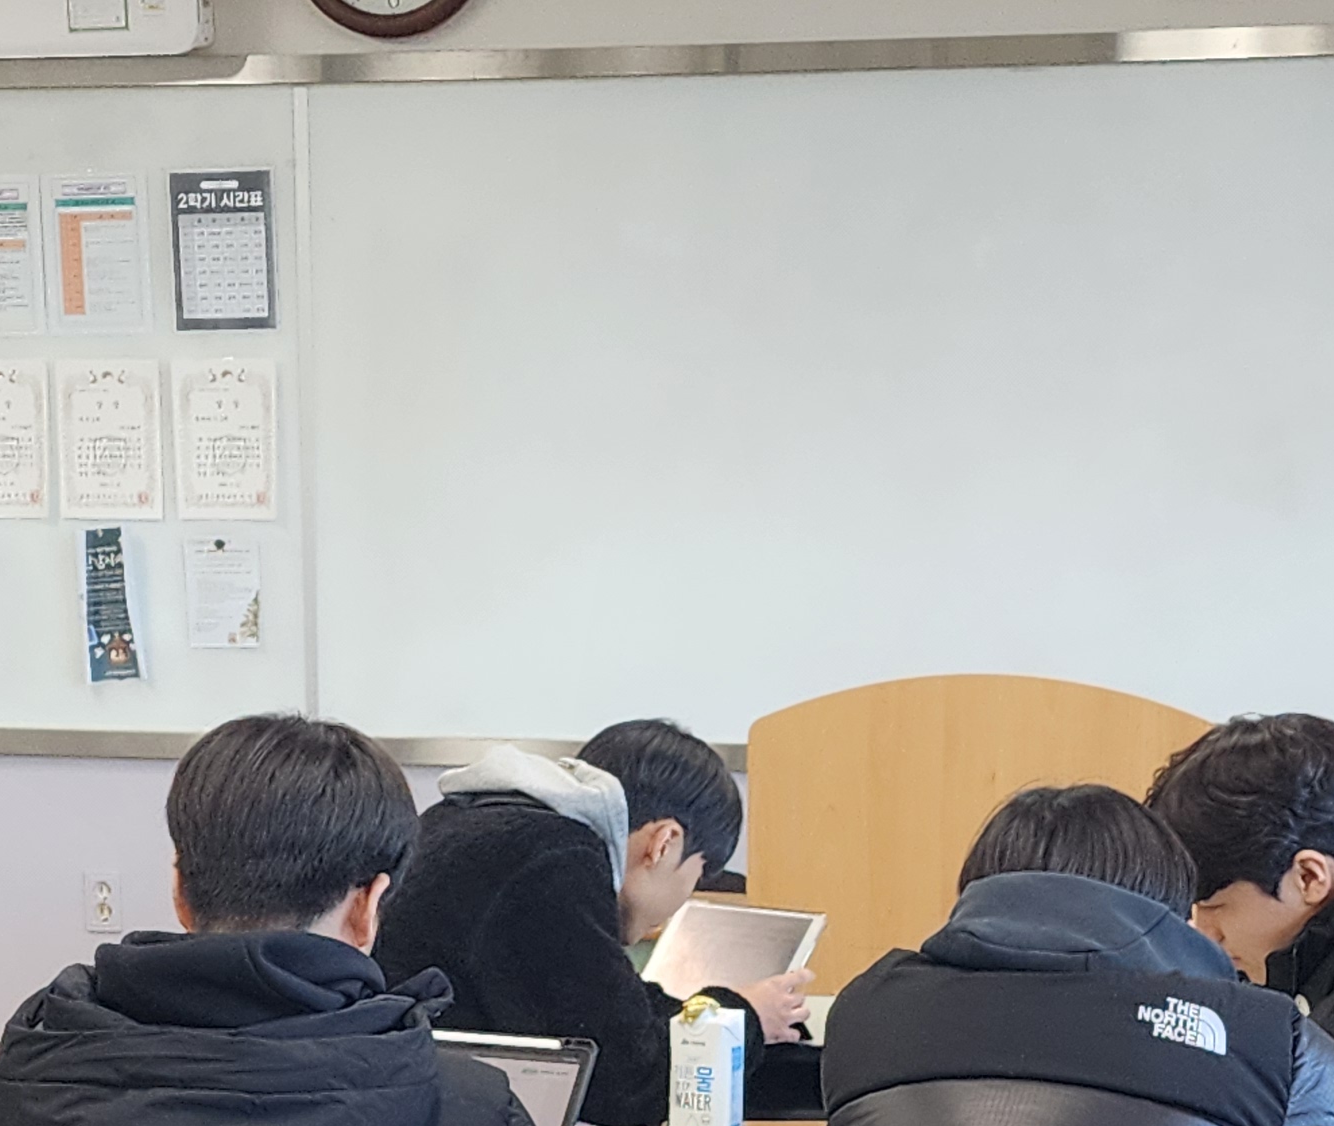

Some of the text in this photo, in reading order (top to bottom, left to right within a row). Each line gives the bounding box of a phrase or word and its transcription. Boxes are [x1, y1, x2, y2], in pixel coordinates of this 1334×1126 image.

[177, 190, 263, 208] 2학기 시간표
[1166, 997, 1200, 1017] THE
[1137, 1005, 1199, 1031] NORTH
[1152, 1023, 1197, 1045] FACE
[675, 1091, 712, 1112] WATER
